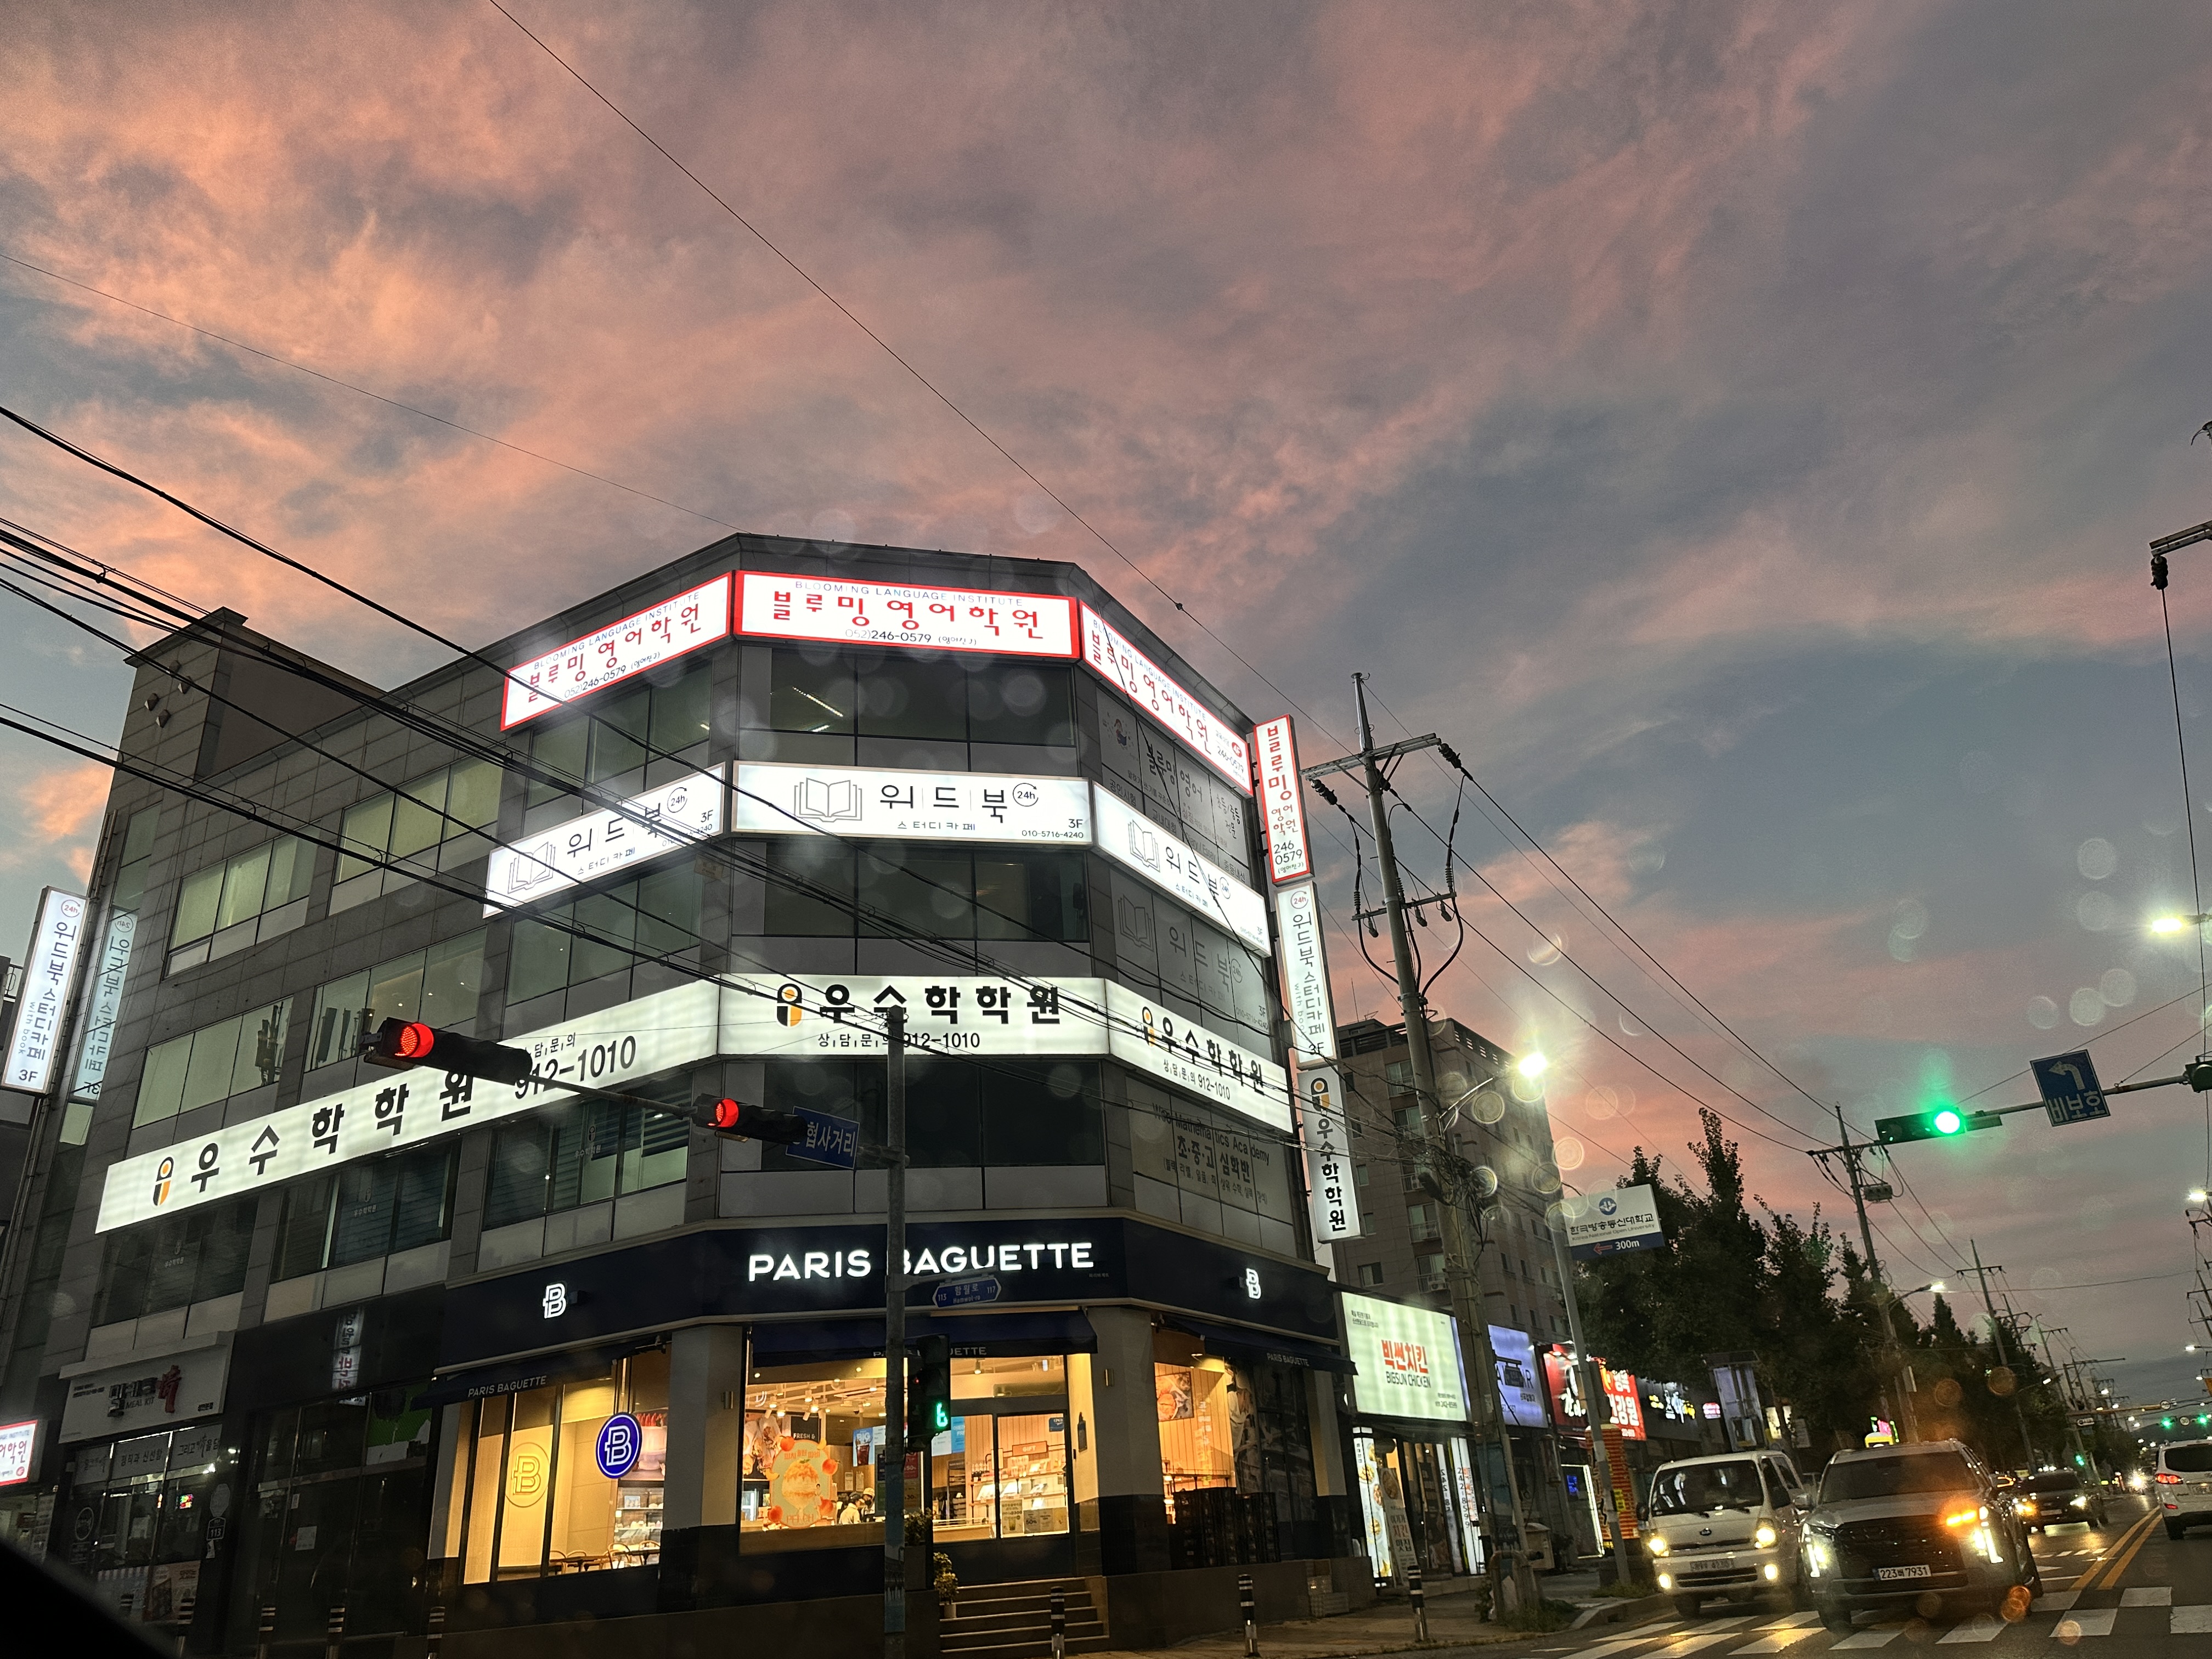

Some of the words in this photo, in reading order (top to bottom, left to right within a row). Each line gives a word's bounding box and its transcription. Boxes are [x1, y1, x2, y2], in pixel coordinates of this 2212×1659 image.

[795, 581, 869, 595] BLOOMING
[876, 588, 948, 601] LANGUAGE
[953, 594, 1023, 607] INSTITUTE
[534, 643, 585, 670] BLOOMING
[589, 617, 641, 646] LANGUAGE
[645, 592, 699, 621] INSTITUTE
[1135, 654, 1171, 691] LANGUAGE
[1172, 687, 1206, 720] INSTITUTE
[1267, 725, 1292, 800] 블루밍
[670, 795, 686, 807] 24h
[1109, 778, 1136, 807] 공인시험
[880, 785, 1008, 823] 워드북
[1016, 791, 1036, 800] 24h
[1271, 805, 1293, 821] 영어
[701, 809, 713, 823] 3F
[1068, 818, 1084, 829] 3F
[1021, 830, 1084, 838] 010-5716-4240
[1273, 819, 1298, 836] 학원
[1274, 840, 1294, 854] 246
[1275, 849, 1302, 865] 0579
[1165, 847, 1219, 897] 워드북
[64, 905, 77, 913] 24h
[1293, 912, 1314, 967] 워드북
[47, 922, 76, 985] 워드북
[1169, 927, 1229, 992] 워드북
[820, 984, 1061, 1025] 우수학학원
[1304, 972, 1324, 1035] 스터디카페
[26, 988, 55, 1060] 스터디카페
[19, 1069, 37, 1082] 3F
[1198, 1075, 1230, 1100] 912-1010
[2048, 1090, 2106, 1122] 비보호
[191, 1071, 473, 1193] 우수학학원
[793, 1121, 856, 1158] 협사거리
[1233, 1136, 1269, 1166] Academy
[1317, 1119, 1346, 1232] 우수학학원
[1570, 1213, 1654, 1235] 한국방송통신대학교
[1628, 1223, 1655, 1232] University
[1615, 1240, 1640, 1250] 300m
[748, 1249, 871, 1282] PARIS
[938, 1294, 947, 1302] 113
[955, 1283, 979, 1296] 함월로
[987, 1286, 996, 1294] 117
[953, 1295, 981, 1304] Hamwol-ro
[1267, 1353, 1282, 1363] PARIS
[467, 1384, 495, 1397] PARIS
[497, 1375, 547, 1393] BAGUETTE
[1408, 1374, 1431, 1389] CHICKEN
[856, 1432, 871, 1441] BIG
[1022, 1444, 1036, 1453] GIFT
[1905, 1567, 1928, 1577] 7931
